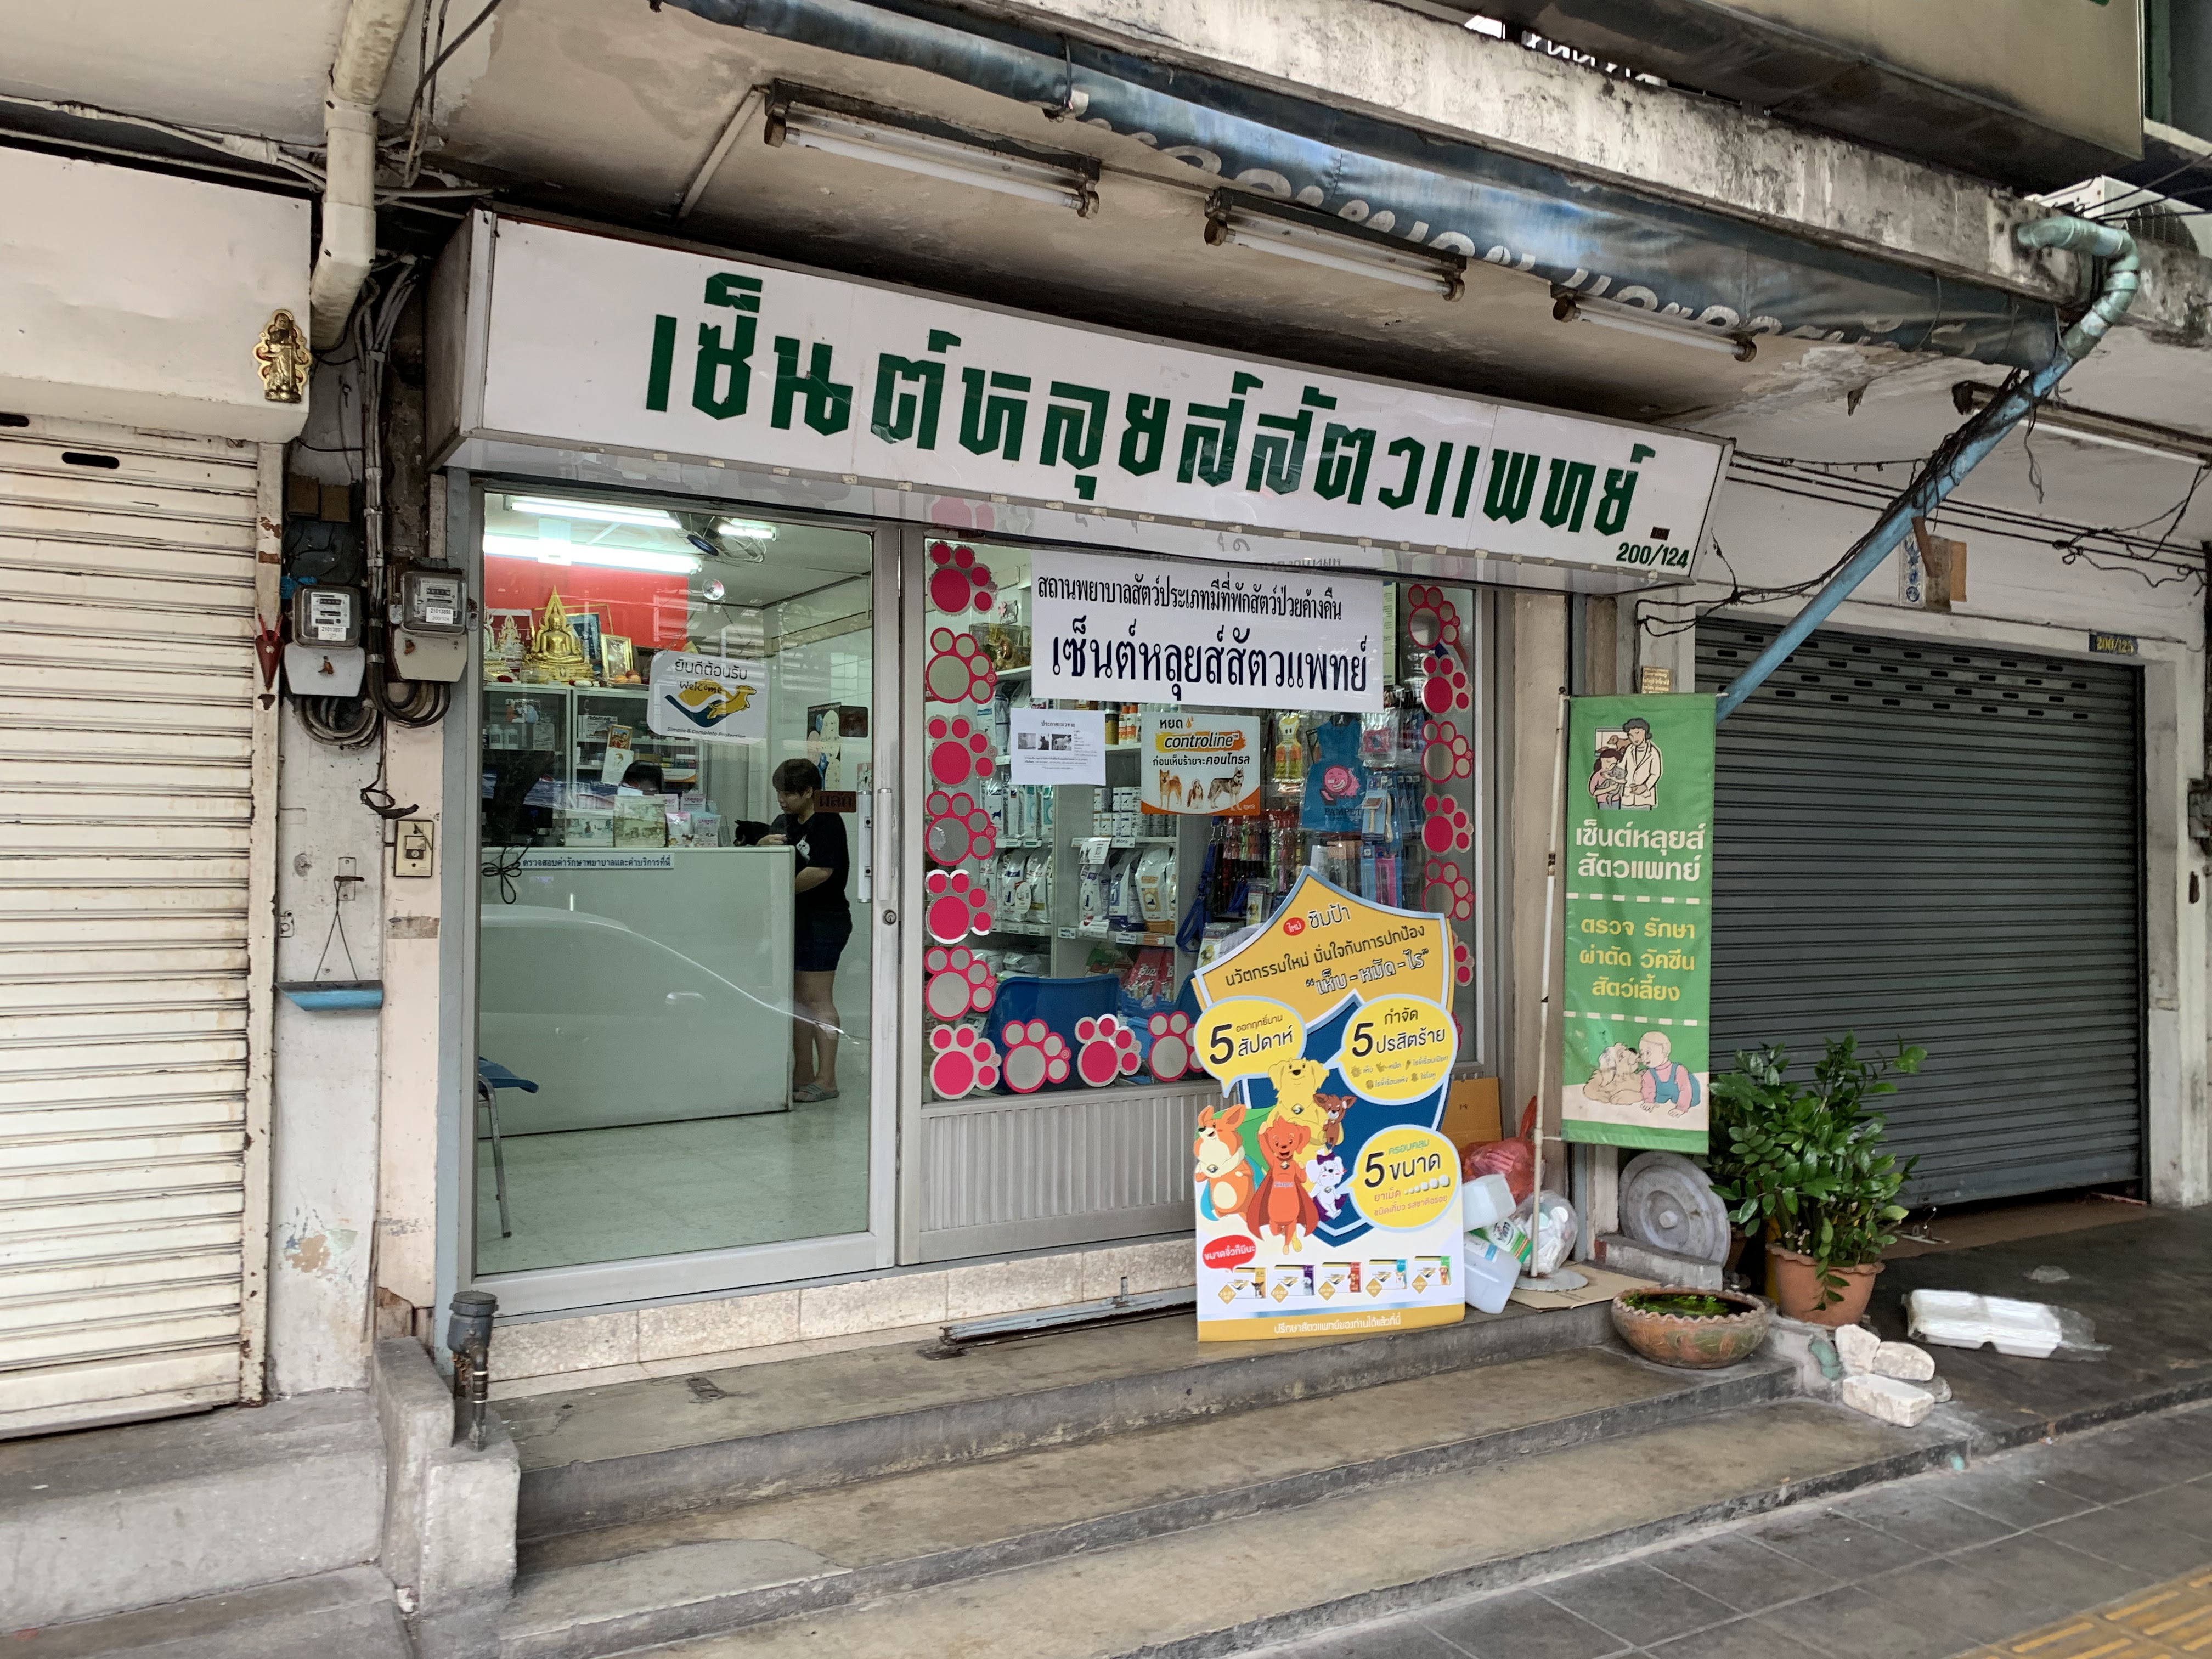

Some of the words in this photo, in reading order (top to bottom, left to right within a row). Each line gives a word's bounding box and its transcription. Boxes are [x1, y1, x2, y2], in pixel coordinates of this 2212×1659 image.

[645, 271, 1656, 536] เซ็นต์หลุยส์สัตวแพทย์
[1615, 541, 1690, 568] 200/124
[1037, 572, 1342, 621] สถานพยาบาลสัตว์ประเภทมีที่พักสัตว์ป่วยค้างคืน
[675, 658, 748, 680] ยินดีต้อนรับ
[1052, 614, 1368, 701] เซ็นต์หลุยส์สัตวแพทย์
[1159, 719, 1183, 729] หยด
[1153, 752, 1250, 766] ก่อนเห็บร้ายจะคอนโทรล
[1575, 817, 1706, 856] เซ็นต์หลุยส์
[1578, 851, 1701, 882] สัตวแพทย์
[1581, 918, 1635, 936] ตรวจ
[1644, 916, 1695, 939] รักษา
[1225, 952, 1310, 986] นวัตกรรมใหม่
[1313, 925, 1425, 964] มั่นใจกับการปกป้อง
[1579, 945, 1632, 968] ผ่าตัด
[1640, 949, 1695, 971] วัคซีน
[1592, 974, 1680, 1002] สัตว์เลี้ยง
[1384, 1007, 1419, 1025] กำจัด
[1210, 1023, 1234, 1065] 5
[1238, 1024, 1293, 1057] สัปดาห์
[1352, 1022, 1374, 1058] 5
[1376, 1026, 1446, 1054] ปรสิตร้าย
[1364, 1152, 1385, 1188] 5
[1389, 1153, 1441, 1181] ขนาด
[1374, 1187, 1401, 1202] ยาเม็ด
